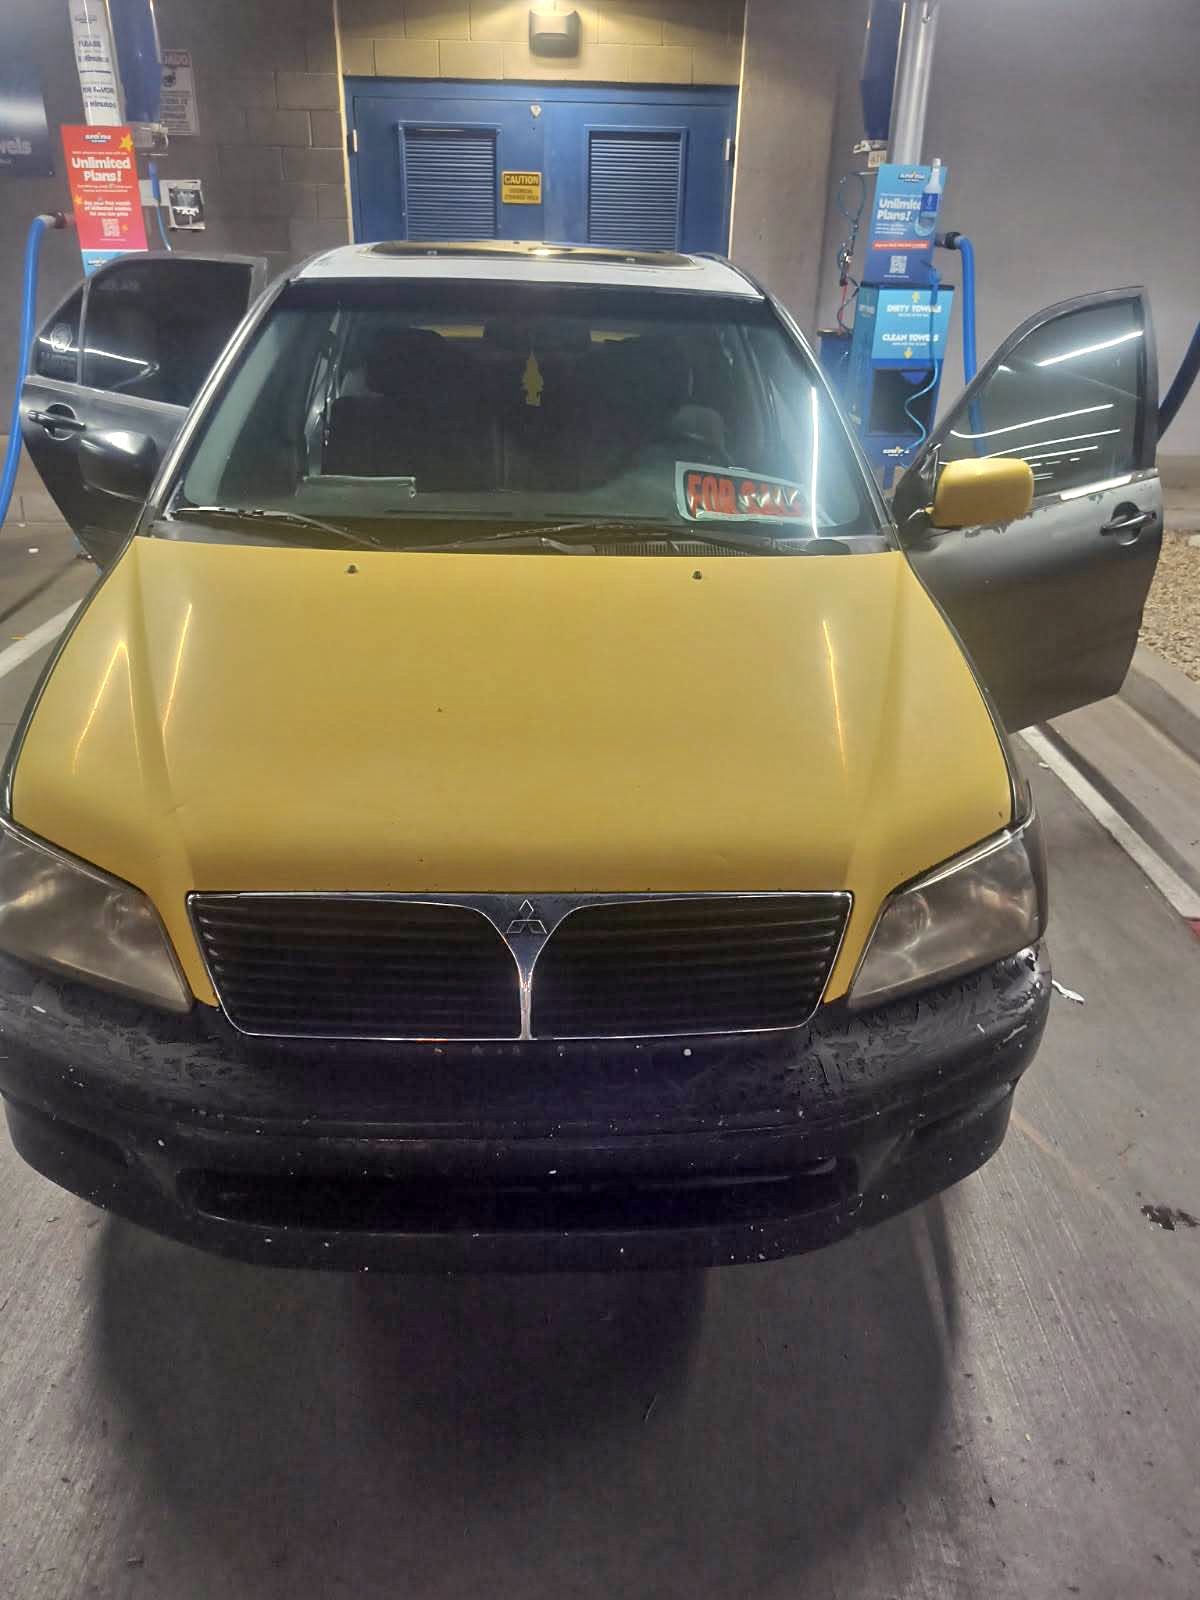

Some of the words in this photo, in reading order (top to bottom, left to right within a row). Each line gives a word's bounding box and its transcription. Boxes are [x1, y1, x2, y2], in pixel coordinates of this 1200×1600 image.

[71, 156, 131, 169] Unlimited
[83, 170, 122, 182] Plans!
[504, 175, 539, 185] CAUTION
[879, 197, 922, 210] Unlimit
[877, 209, 912, 221] Plans!
[886, 304, 909, 313] DIRTY
[882, 334, 907, 342] CLEAN
[909, 334, 939, 342] TOWES
[687, 472, 736, 519] FOR
